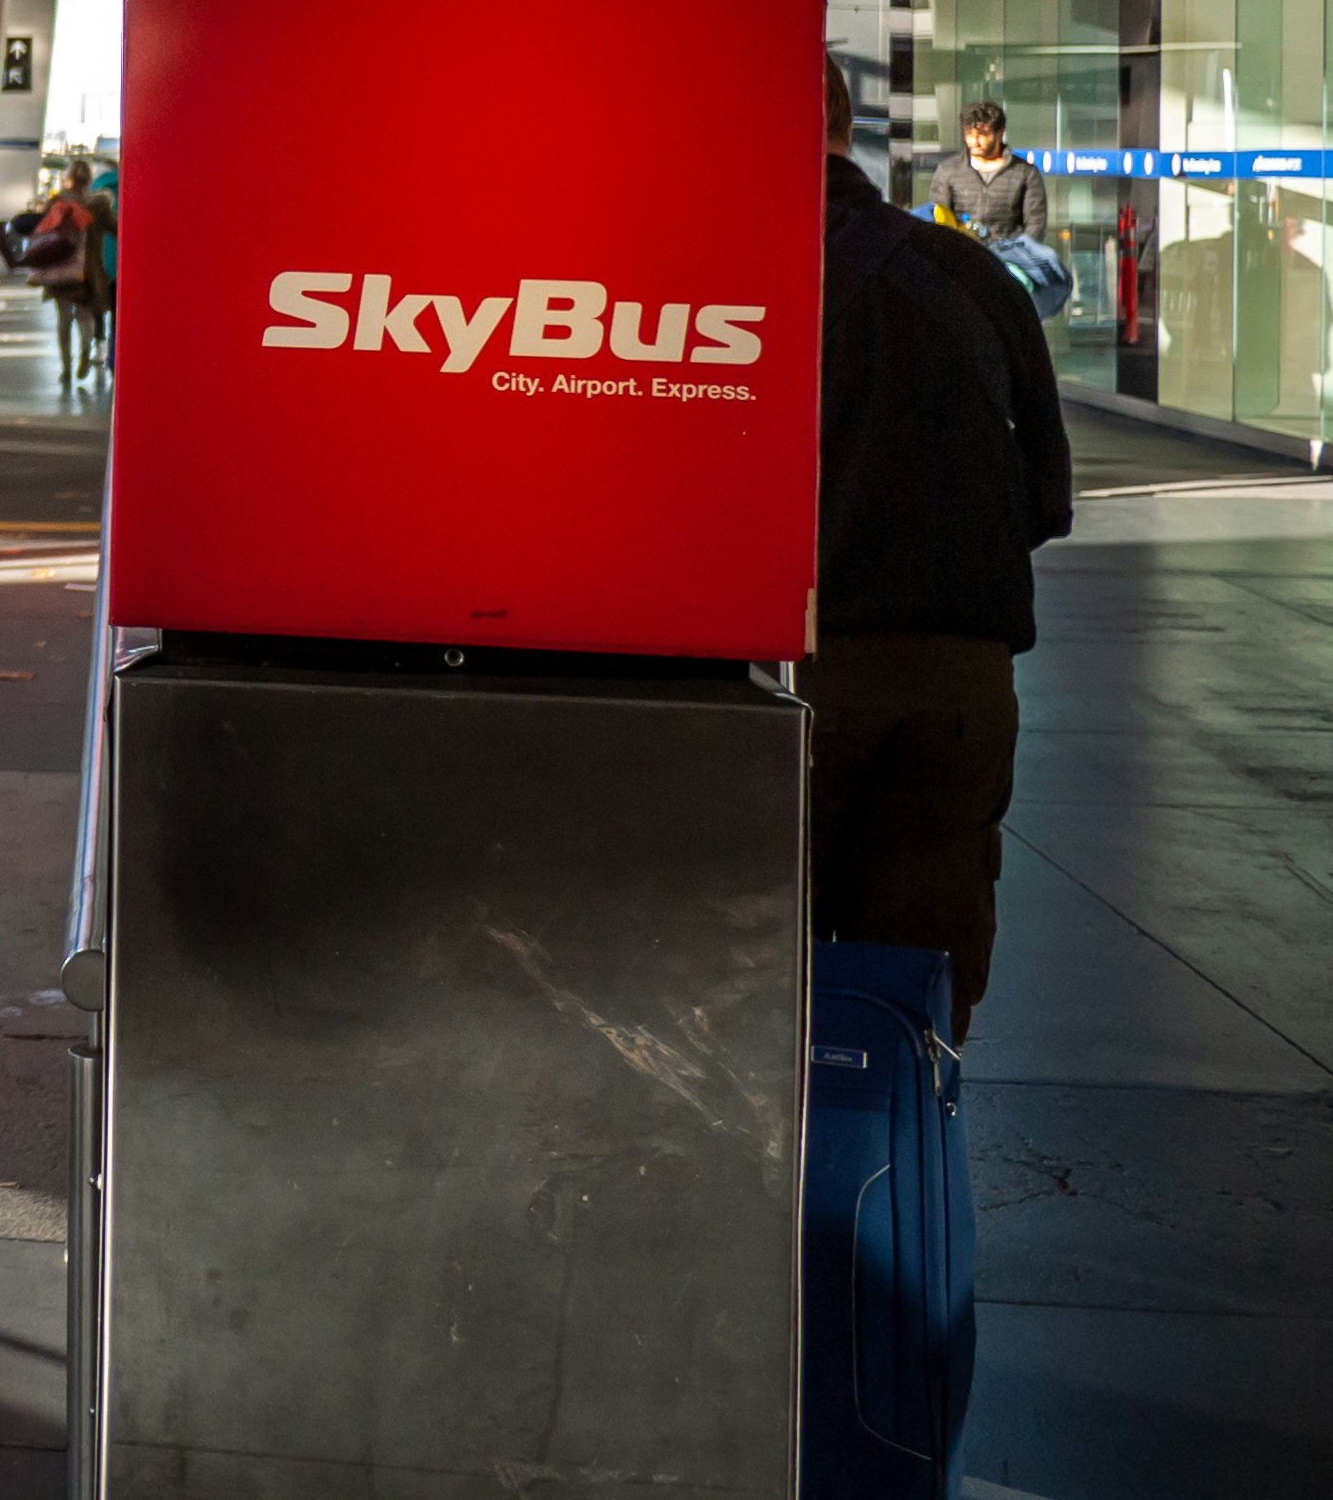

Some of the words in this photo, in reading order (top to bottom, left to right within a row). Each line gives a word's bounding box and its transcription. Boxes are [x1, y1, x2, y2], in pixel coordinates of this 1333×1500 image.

[262, 271, 767, 373] SkyBus
[492, 371, 545, 396] City.
[552, 375, 644, 399] Airport.
[652, 378, 757, 402] Express.
